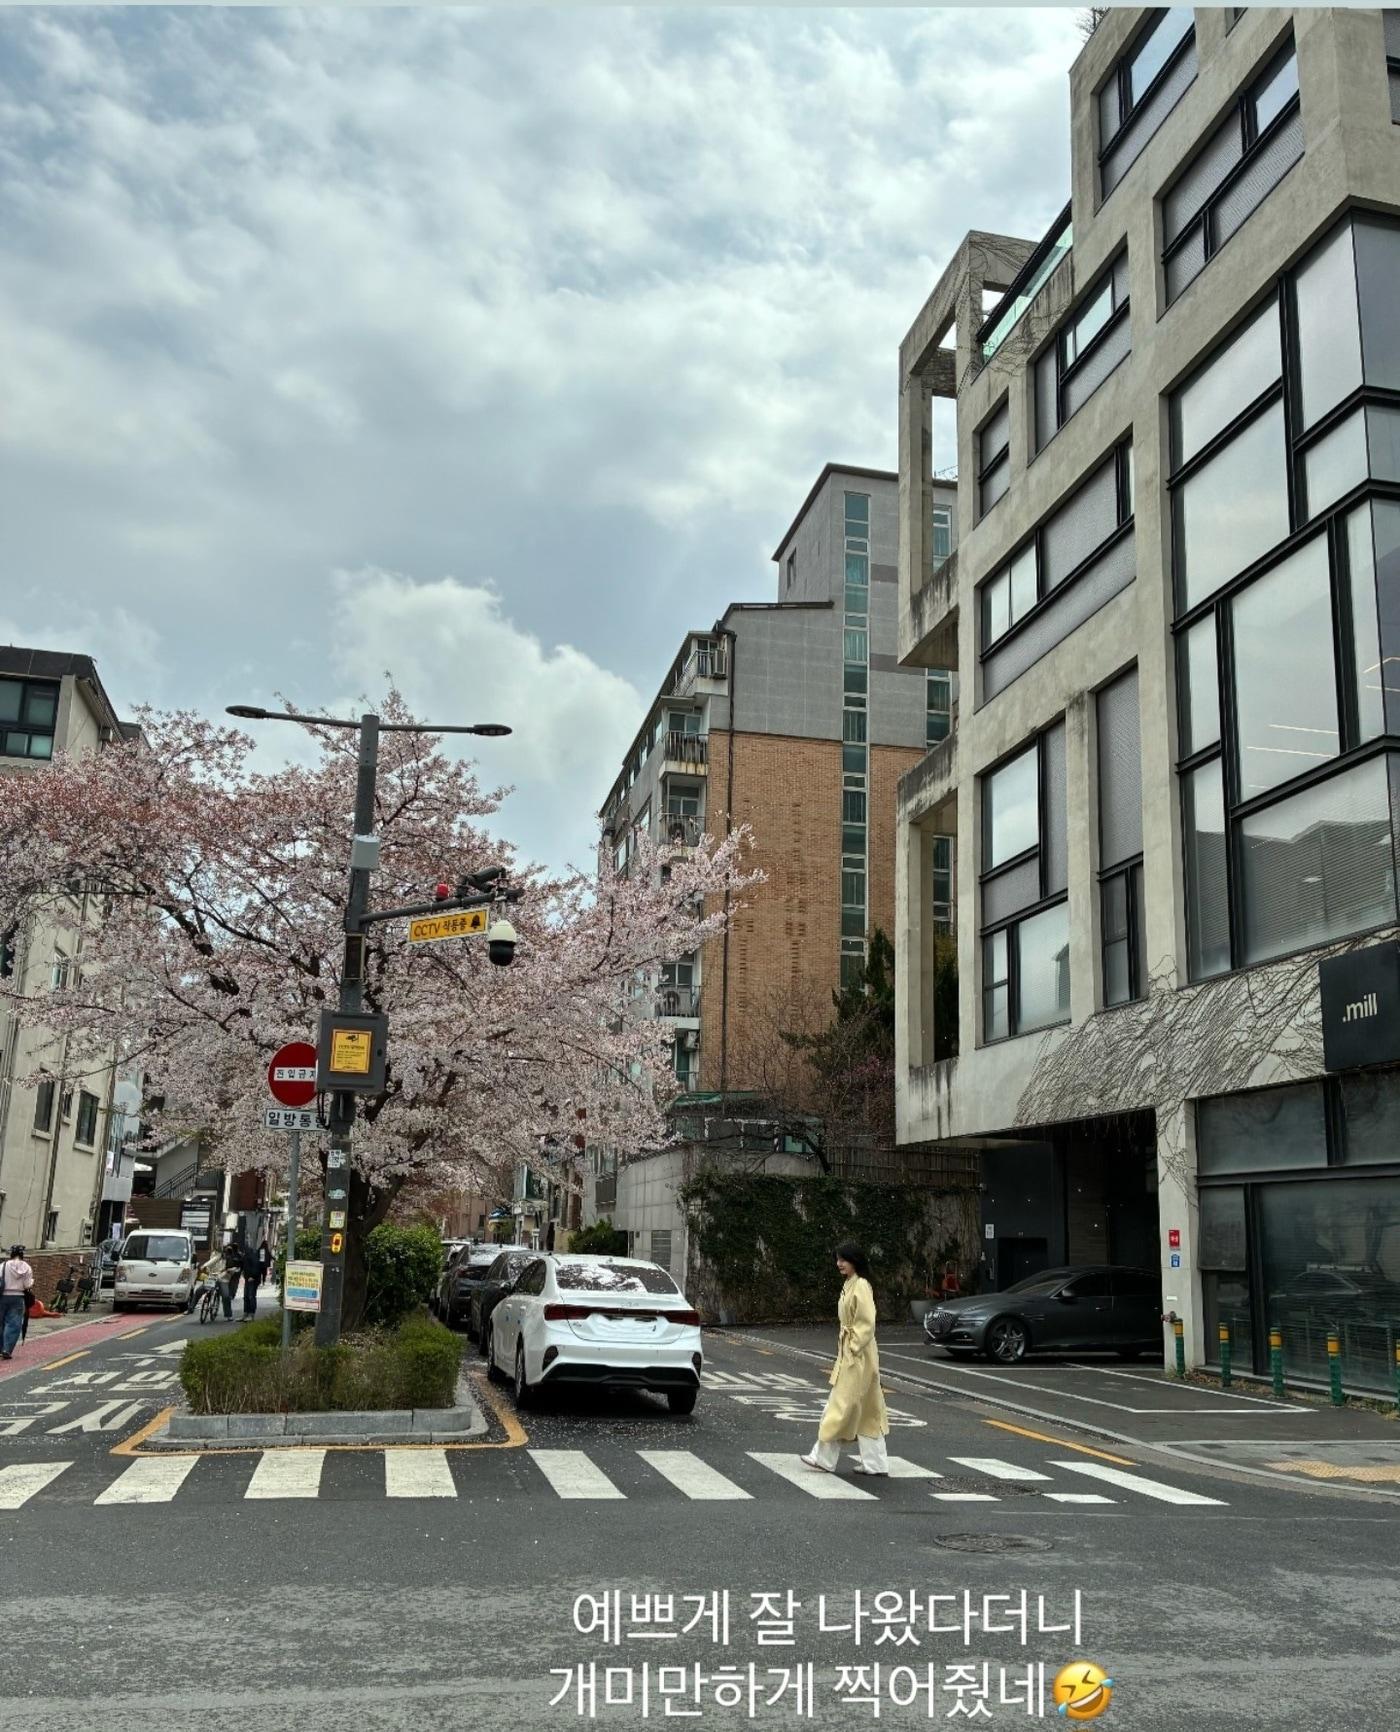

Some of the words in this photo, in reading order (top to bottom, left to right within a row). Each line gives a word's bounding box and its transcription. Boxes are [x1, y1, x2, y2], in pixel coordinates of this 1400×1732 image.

[413, 921, 441, 937] CCTV
[442, 917, 468, 933] 작동중
[1342, 992, 1378, 1023] .mill
[27, 1370, 181, 1395] 진입
